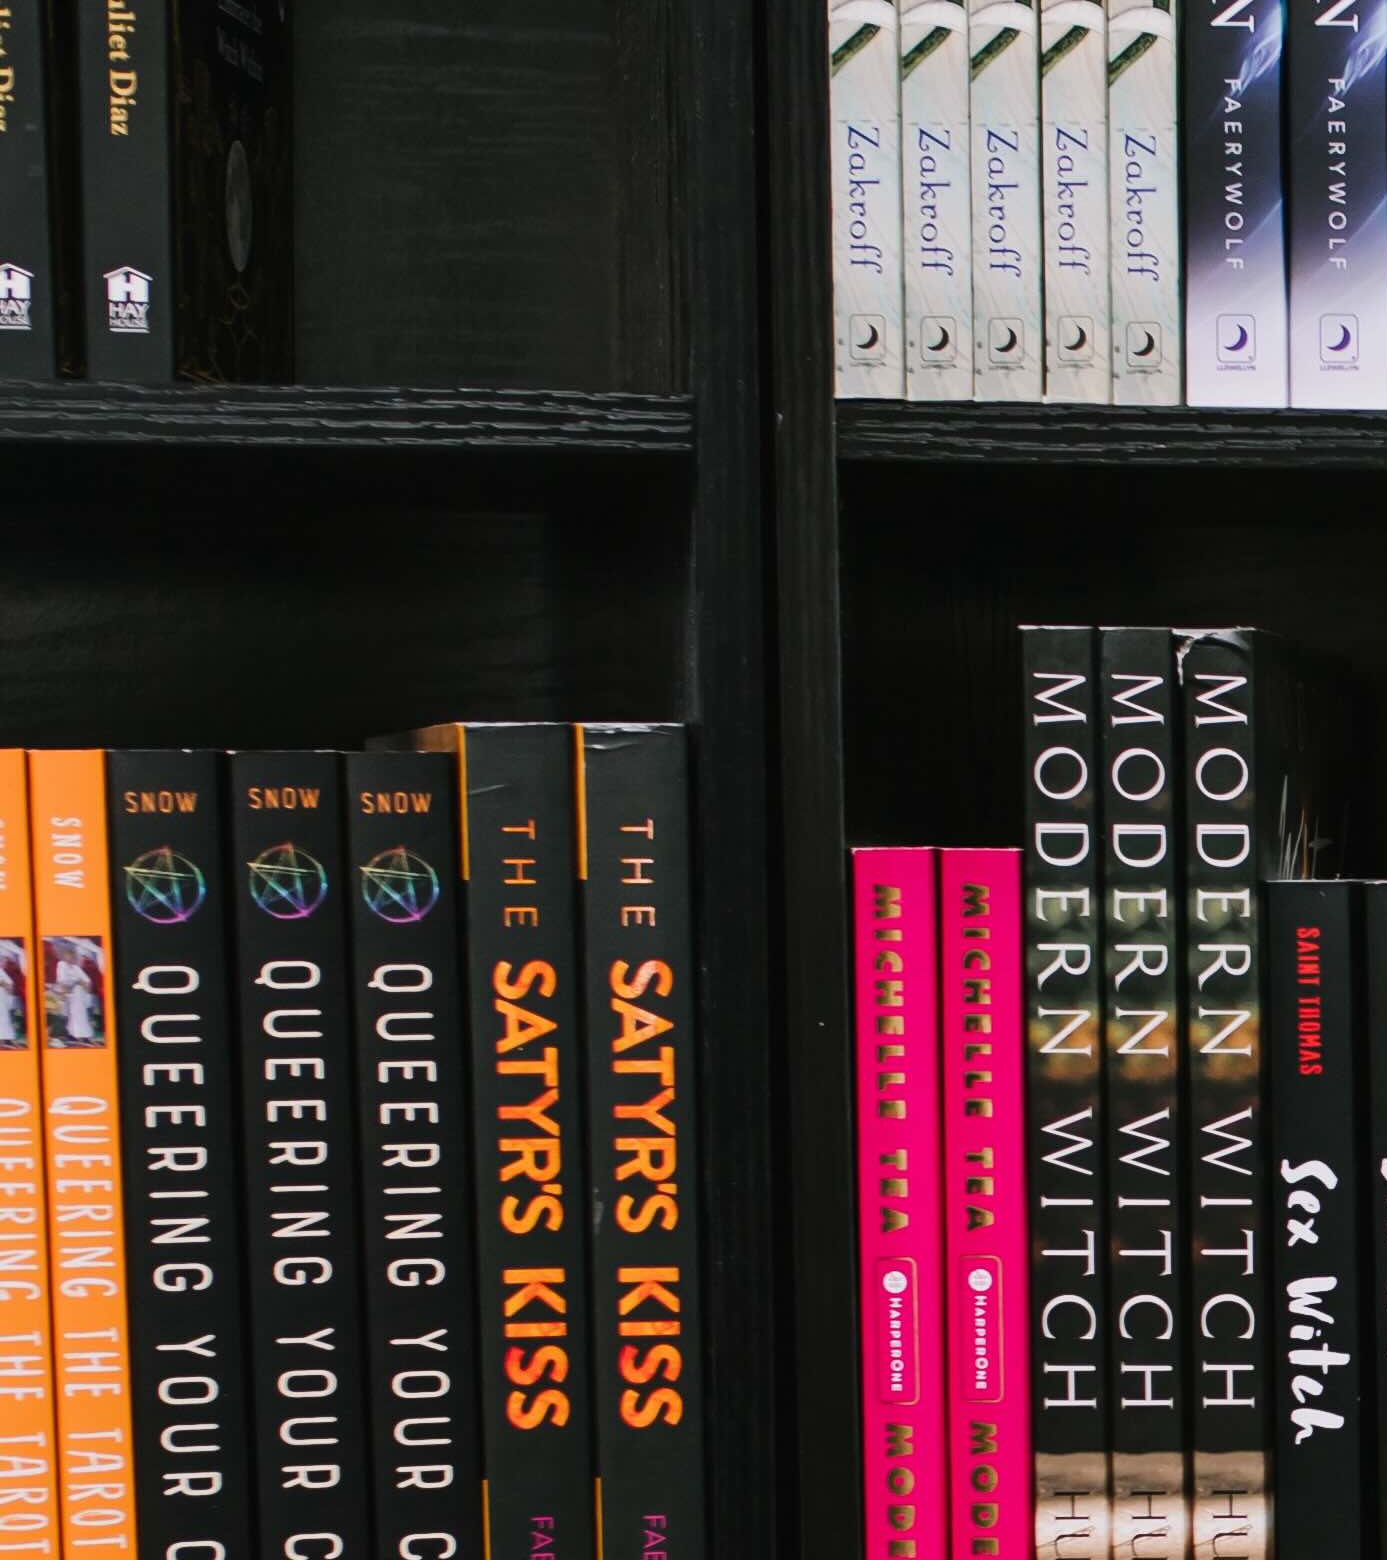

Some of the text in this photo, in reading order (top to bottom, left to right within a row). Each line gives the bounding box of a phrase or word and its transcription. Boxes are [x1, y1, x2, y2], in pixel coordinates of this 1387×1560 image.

[110, 69, 138, 136] Diaz
[1223, 76, 1245, 273] FAERYWOLF
[845, 125, 880, 274] Zakroff
[108, 302, 150, 318] HAY
[248, 788, 320, 811] SNOW
[618, 817, 654, 927] THE
[1029, 671, 1096, 1410] MODERN WITCH
[1296, 927, 1323, 1075] SAINT THOMAS
[250, 959, 332, 1287] QUEERING
[610, 959, 683, 1430] SATYR'S KISS
[1280, 1157, 1350, 1445] Sex Witch
[275, 1329, 339, 1491] YOUR
